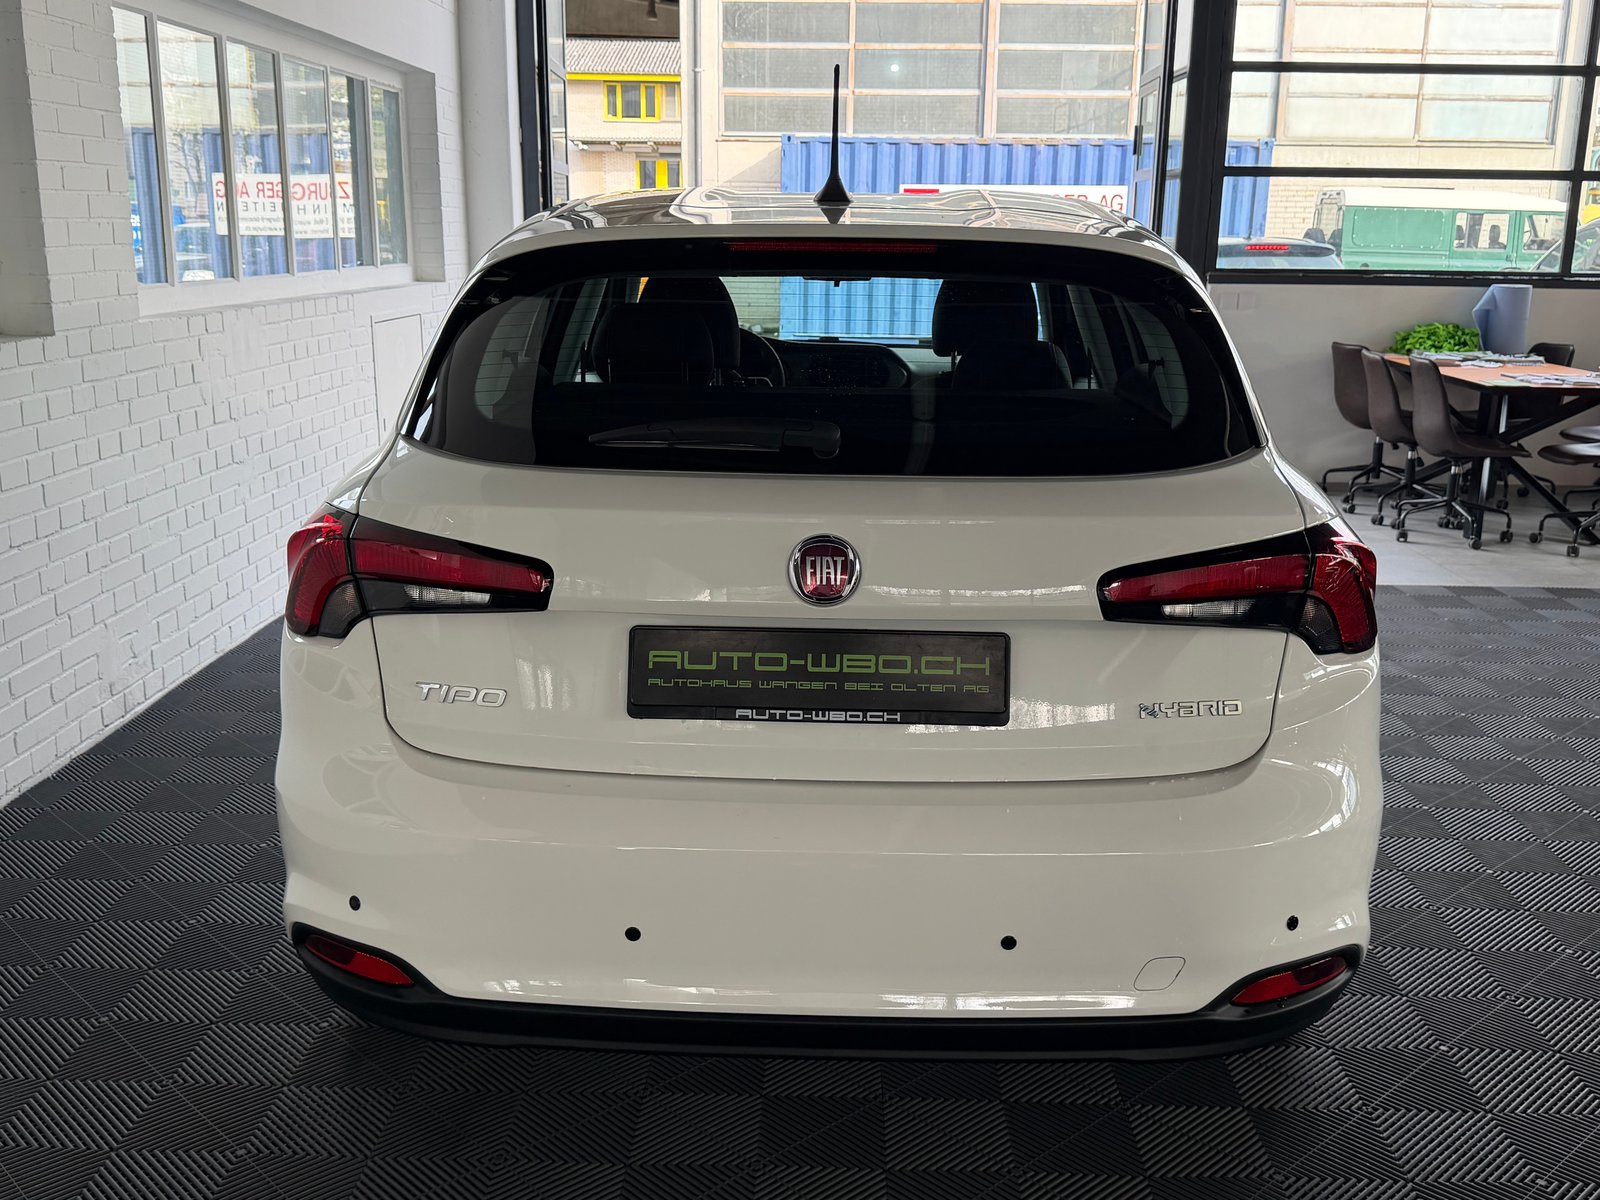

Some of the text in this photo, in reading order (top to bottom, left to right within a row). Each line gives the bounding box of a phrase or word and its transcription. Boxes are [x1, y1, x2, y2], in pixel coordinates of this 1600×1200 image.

[806, 556, 845, 586] FIAT
[648, 650, 990, 676] AUTO-WBO.CH
[415, 681, 508, 708] TIPO
[647, 678, 990, 693] AUTOHAUS WANGEN BEI OLTEN AG
[735, 708, 901, 723] AUTO-WBO.CH
[1138, 700, 1243, 719] HYBRID
